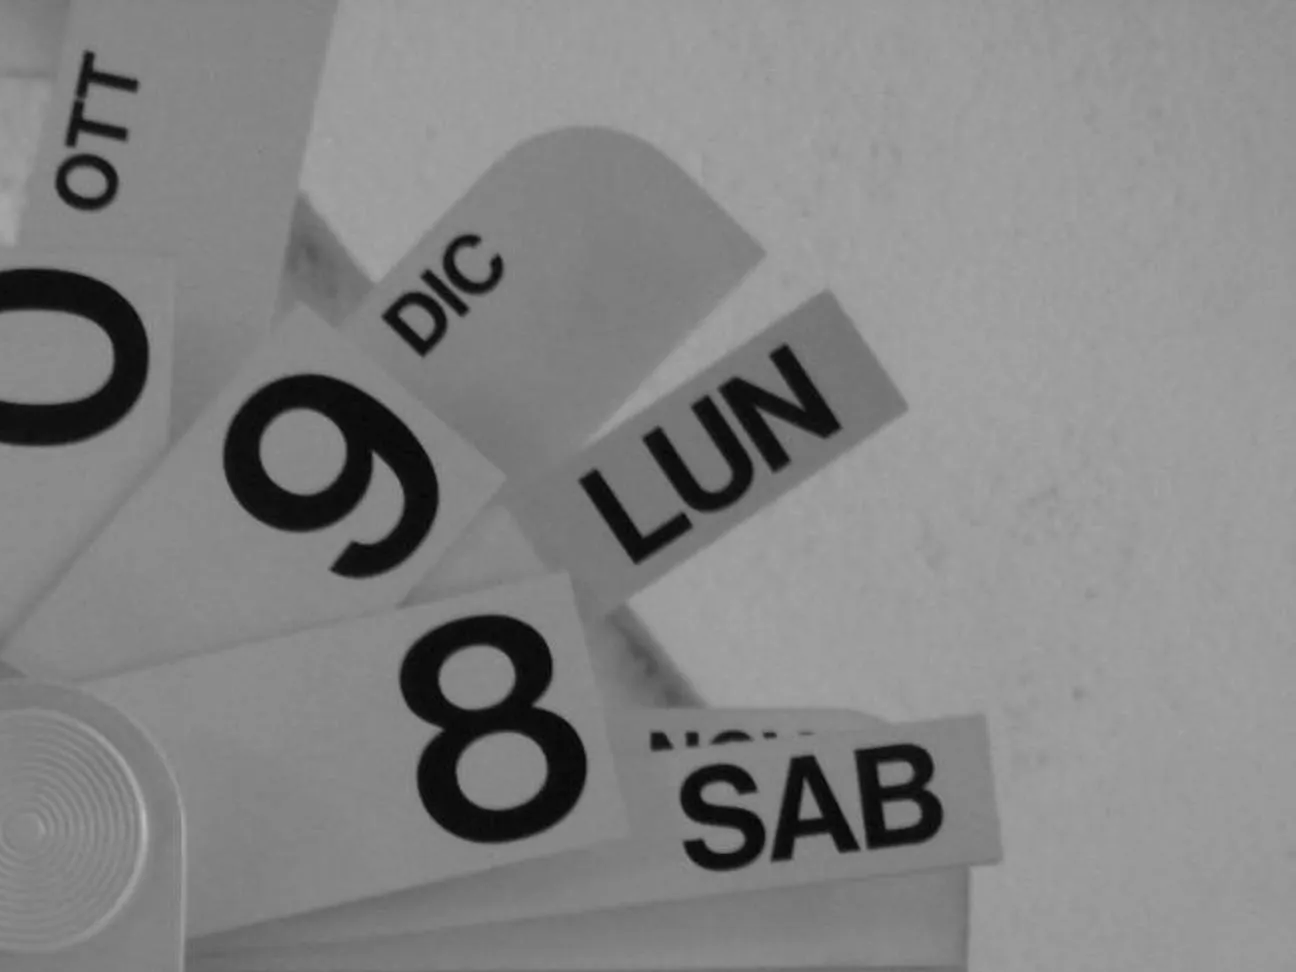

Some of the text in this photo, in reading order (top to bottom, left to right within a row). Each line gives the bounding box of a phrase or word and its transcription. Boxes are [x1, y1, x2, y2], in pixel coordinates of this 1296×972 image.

[54, 51, 140, 211] OTT
[381, 233, 505, 357] DIC
[222, 373, 440, 579] 9
[578, 343, 842, 565] LUN
[398, 613, 588, 845] 8
[679, 742, 944, 873] SAB
